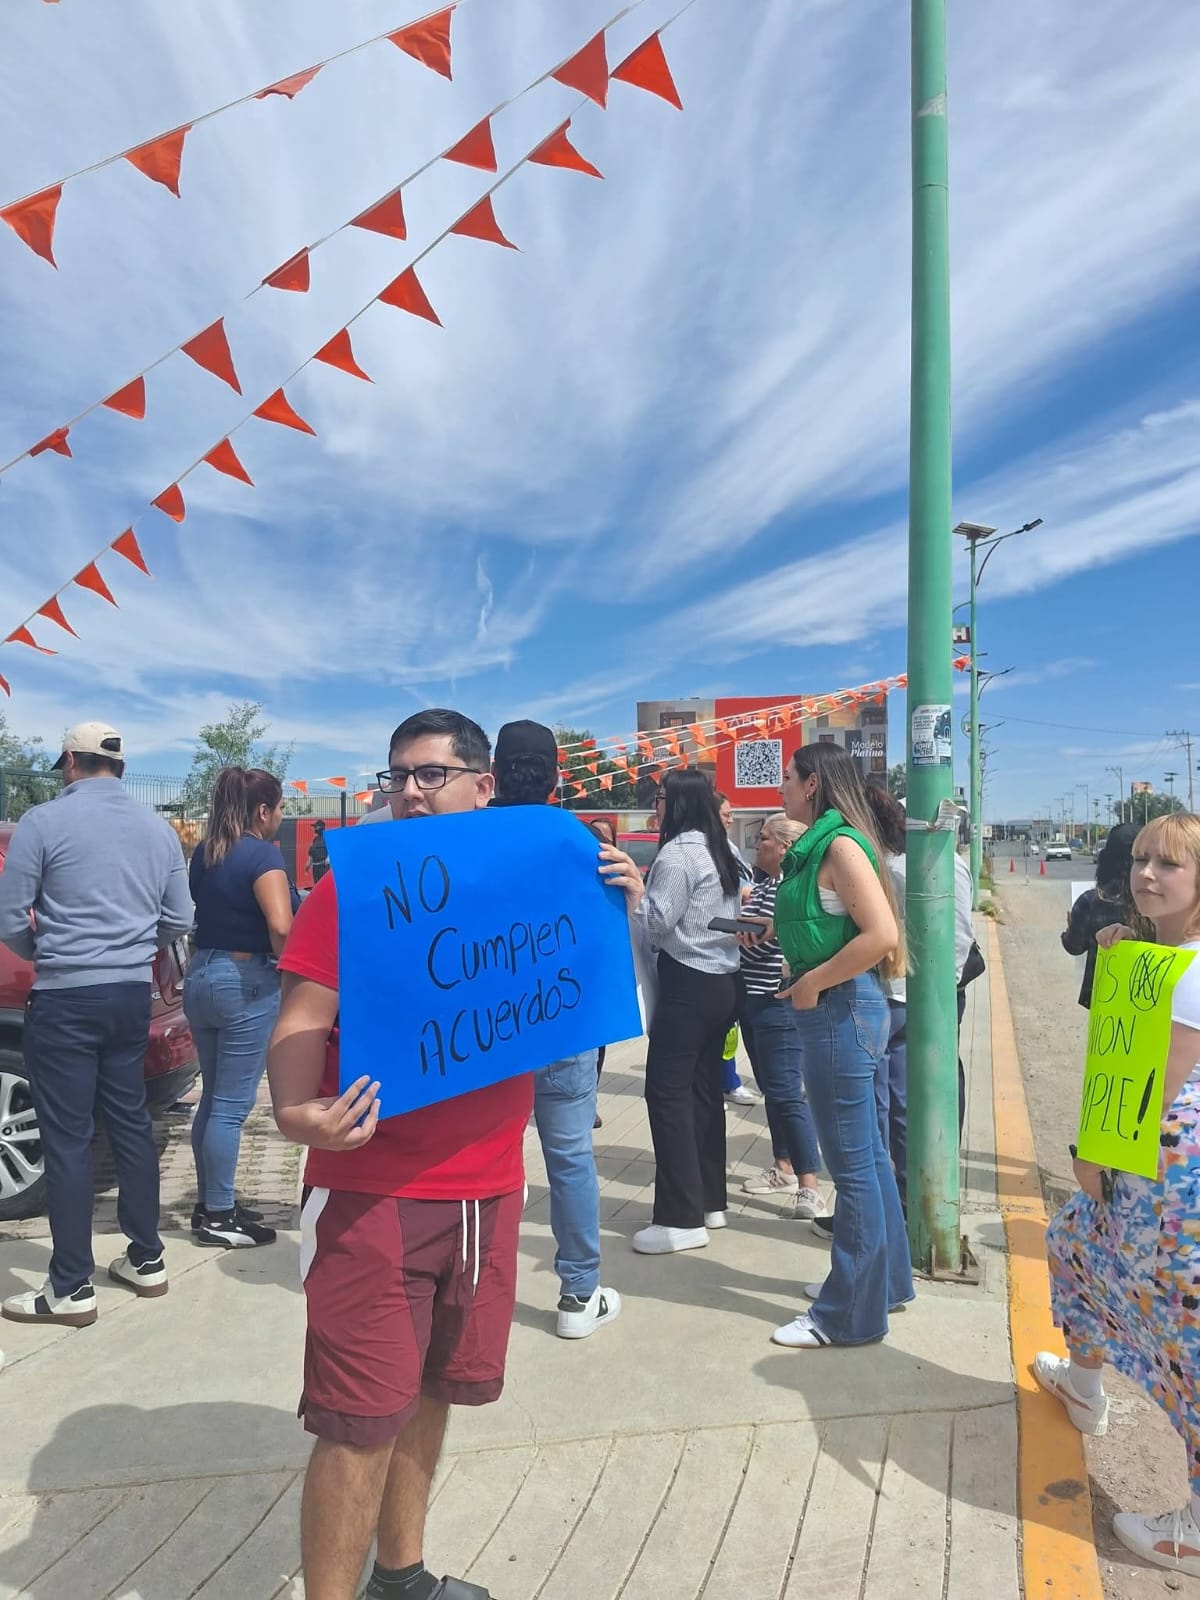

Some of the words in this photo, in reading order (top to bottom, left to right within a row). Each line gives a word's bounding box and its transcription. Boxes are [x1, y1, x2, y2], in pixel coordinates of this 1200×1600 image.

[851, 740, 883, 749] Modelo
[851, 748, 883, 757] Platino
[383, 855, 450, 930] NO
